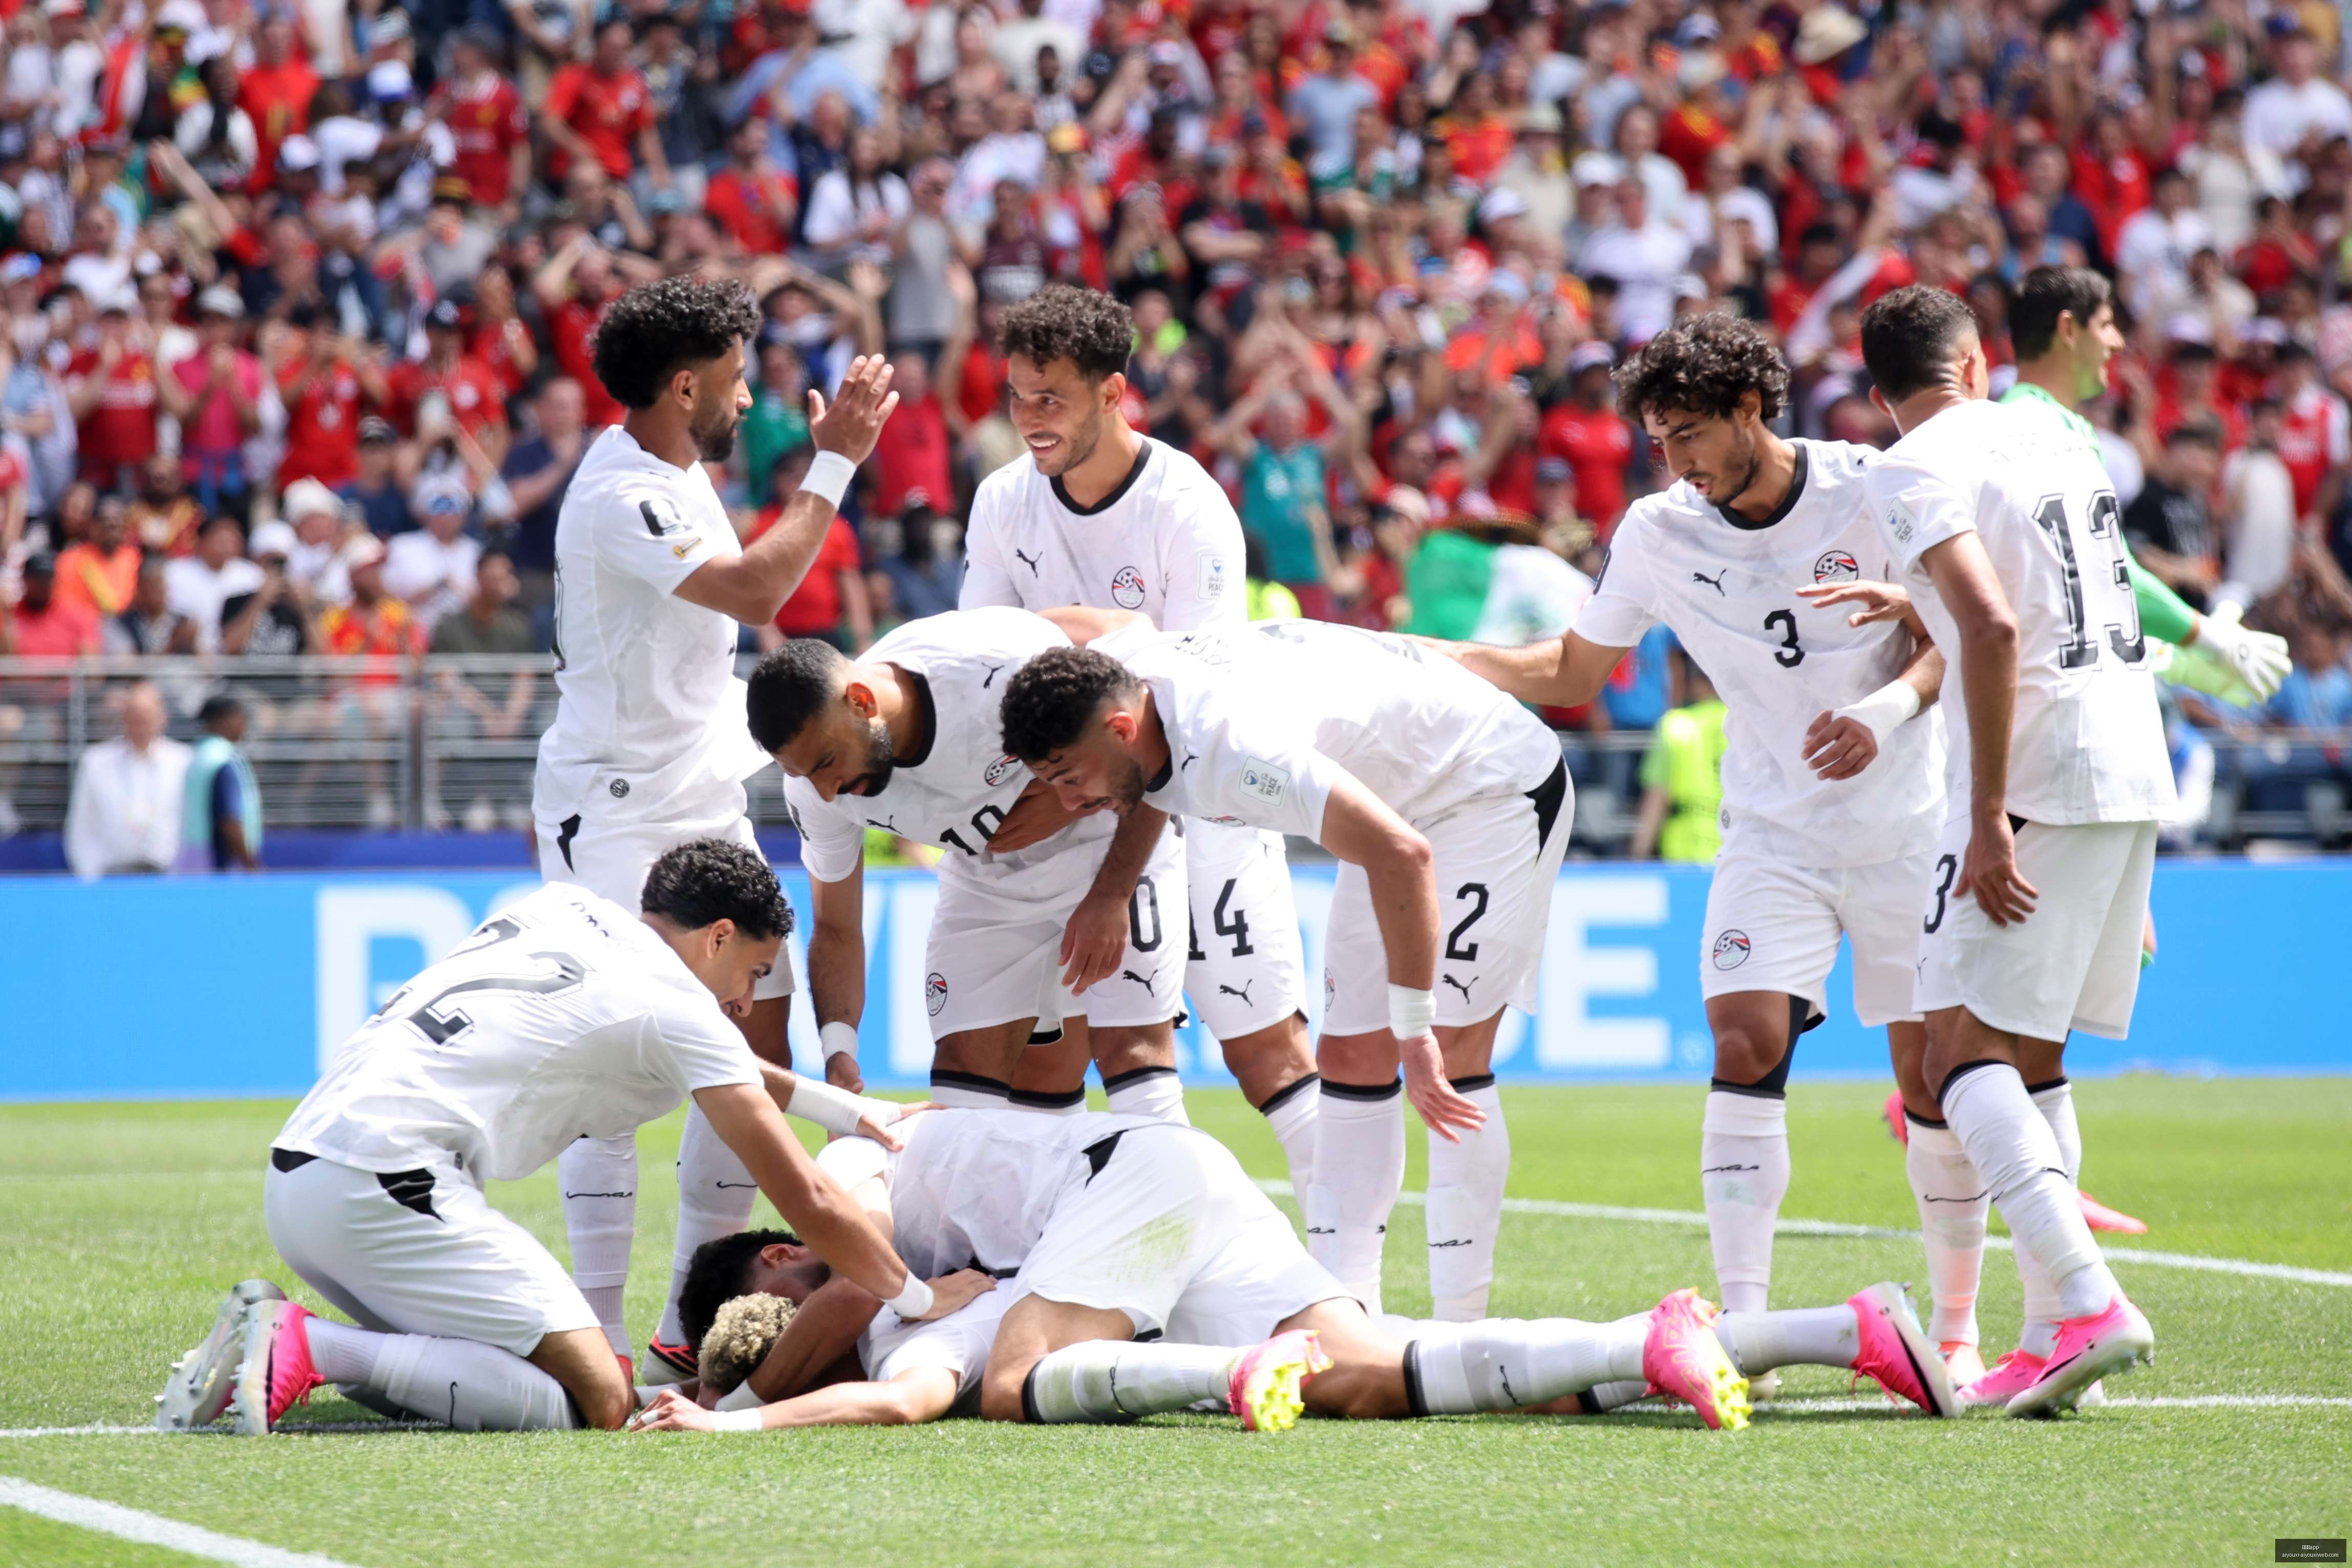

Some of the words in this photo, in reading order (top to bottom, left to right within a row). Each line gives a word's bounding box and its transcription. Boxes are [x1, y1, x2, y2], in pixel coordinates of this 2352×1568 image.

[2032, 489, 2149, 675] 13
[1764, 608, 1805, 668] 3
[1266, 776, 1278, 797] PEACE
[939, 803, 1005, 856] 10
[1129, 875, 1162, 952] 0
[1445, 882, 1489, 961] 2
[1924, 854, 1957, 934] 3
